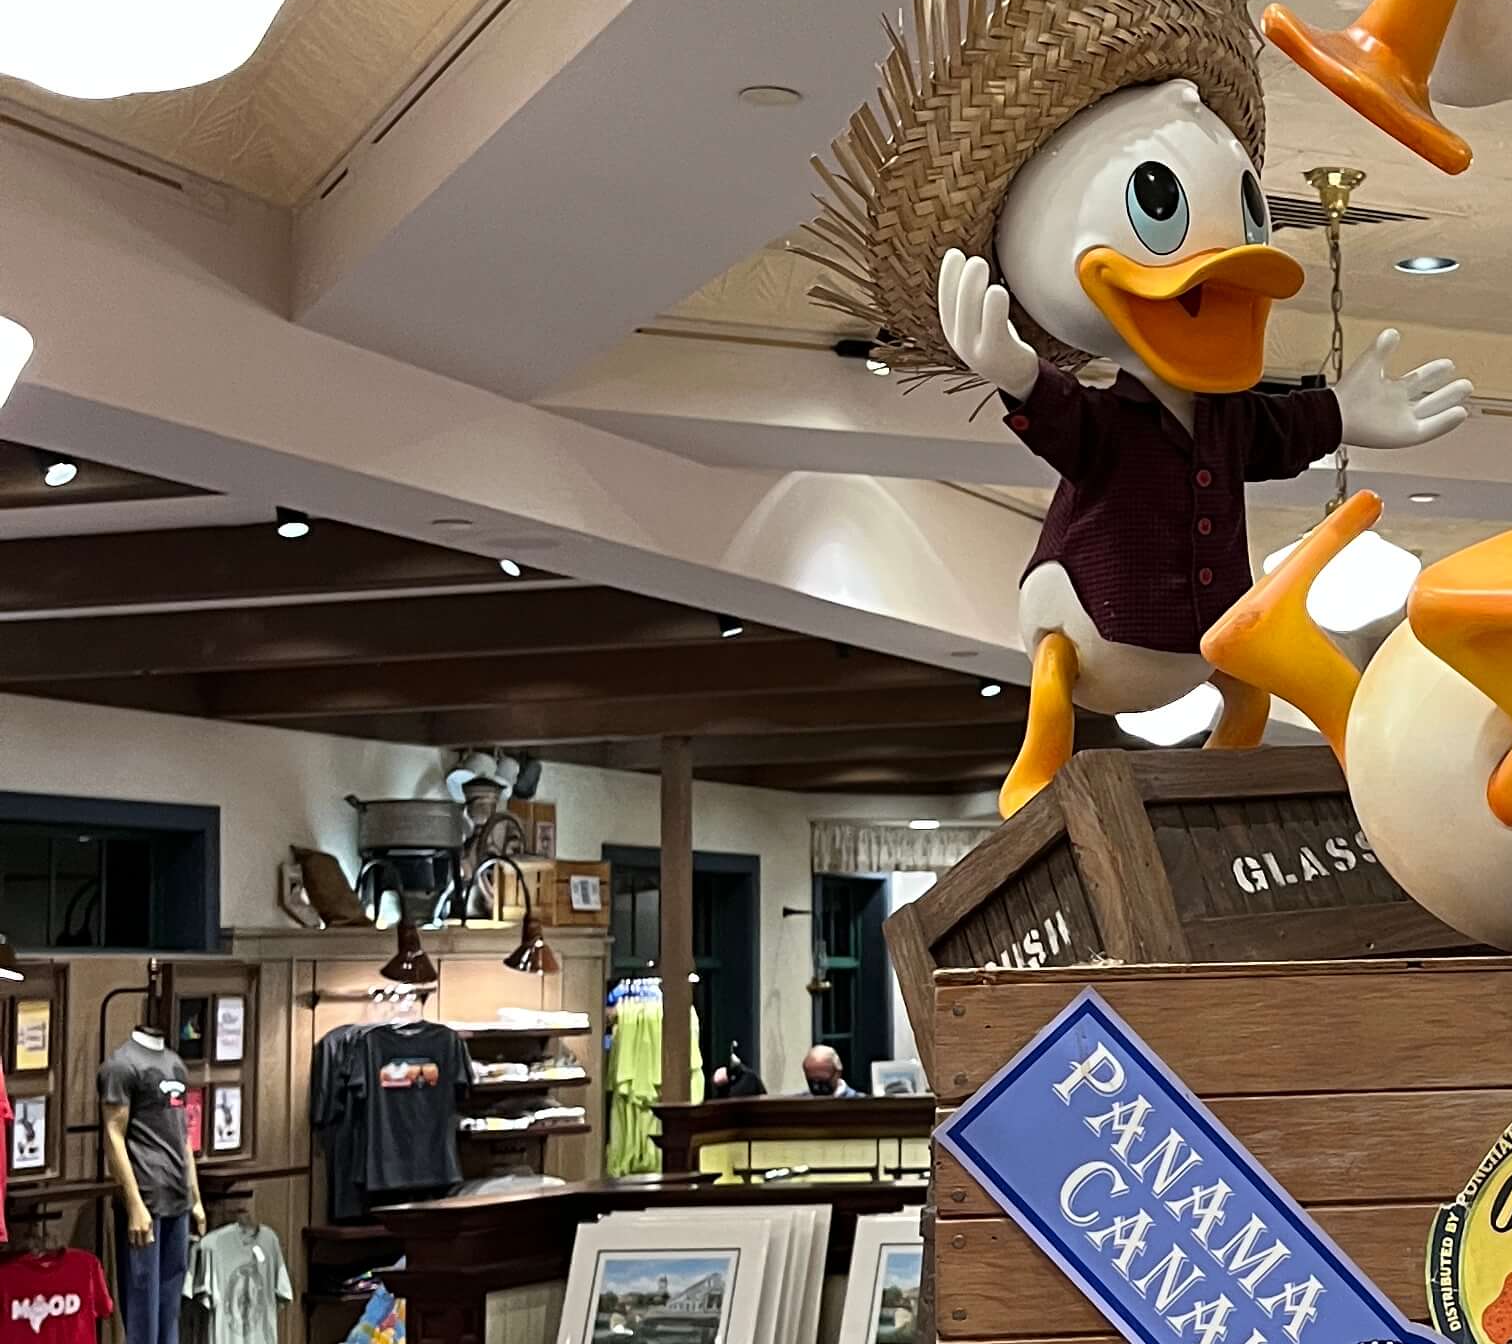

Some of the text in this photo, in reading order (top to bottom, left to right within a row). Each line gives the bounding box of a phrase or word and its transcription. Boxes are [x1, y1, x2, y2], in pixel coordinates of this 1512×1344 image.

[1232, 832, 1377, 894] GLASS
[1440, 1211, 1462, 1332] DISTRIBUTED BY
